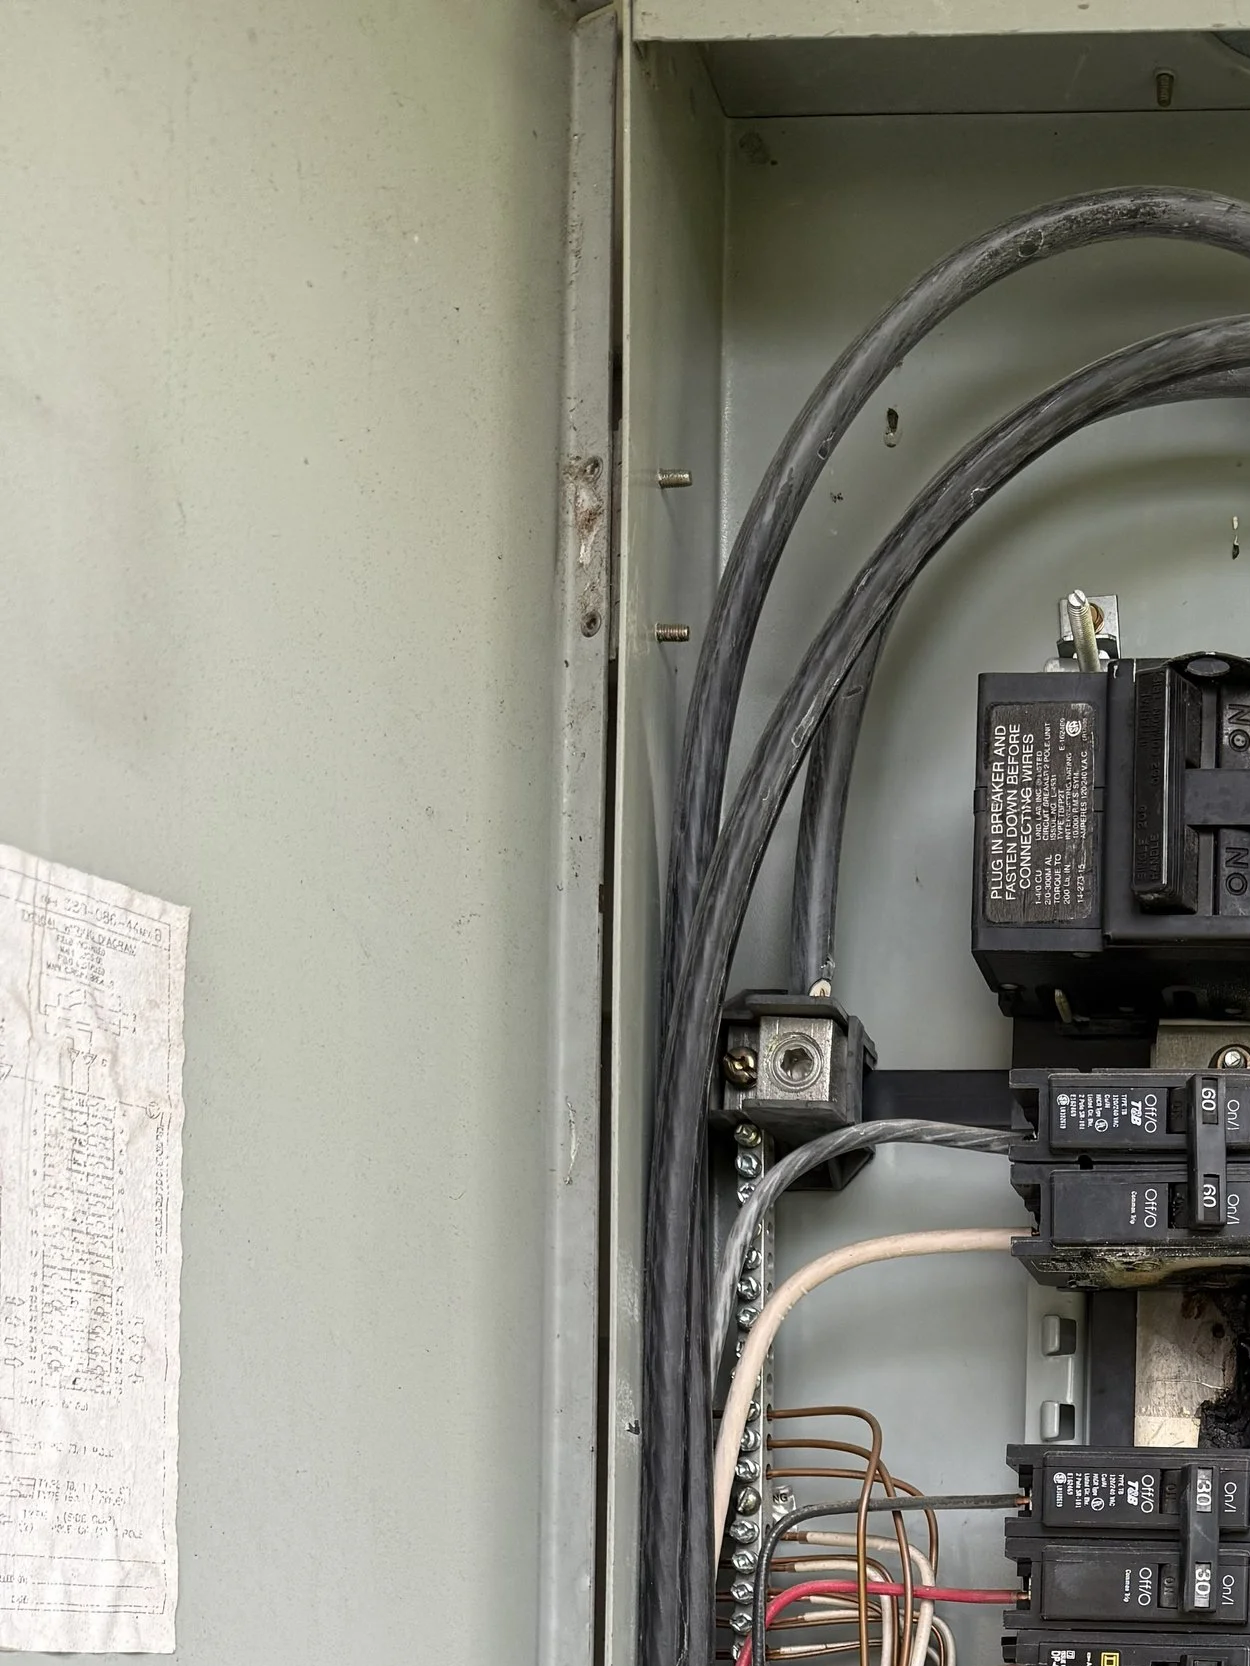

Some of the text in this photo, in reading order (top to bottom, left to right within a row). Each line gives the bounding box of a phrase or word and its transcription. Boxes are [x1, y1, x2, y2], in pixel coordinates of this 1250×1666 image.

[991, 726, 1006, 899] PLUG IN BREAKER AND
[1006, 724, 1020, 900] FASTEN DOWN BEFORE
[1020, 734, 1034, 889] CONNECTING WIRES
[1045, 855, 1052, 865] AL
[1055, 854, 1061, 866] TO
[1225, 844, 1250, 898] ON
[1035, 870, 1042, 883] CU
[1202, 1088, 1216, 1110] 60
[1203, 1184, 1216, 1207] 60
[1197, 1479, 1212, 1507] 30
[1195, 1568, 1211, 1595] 30
